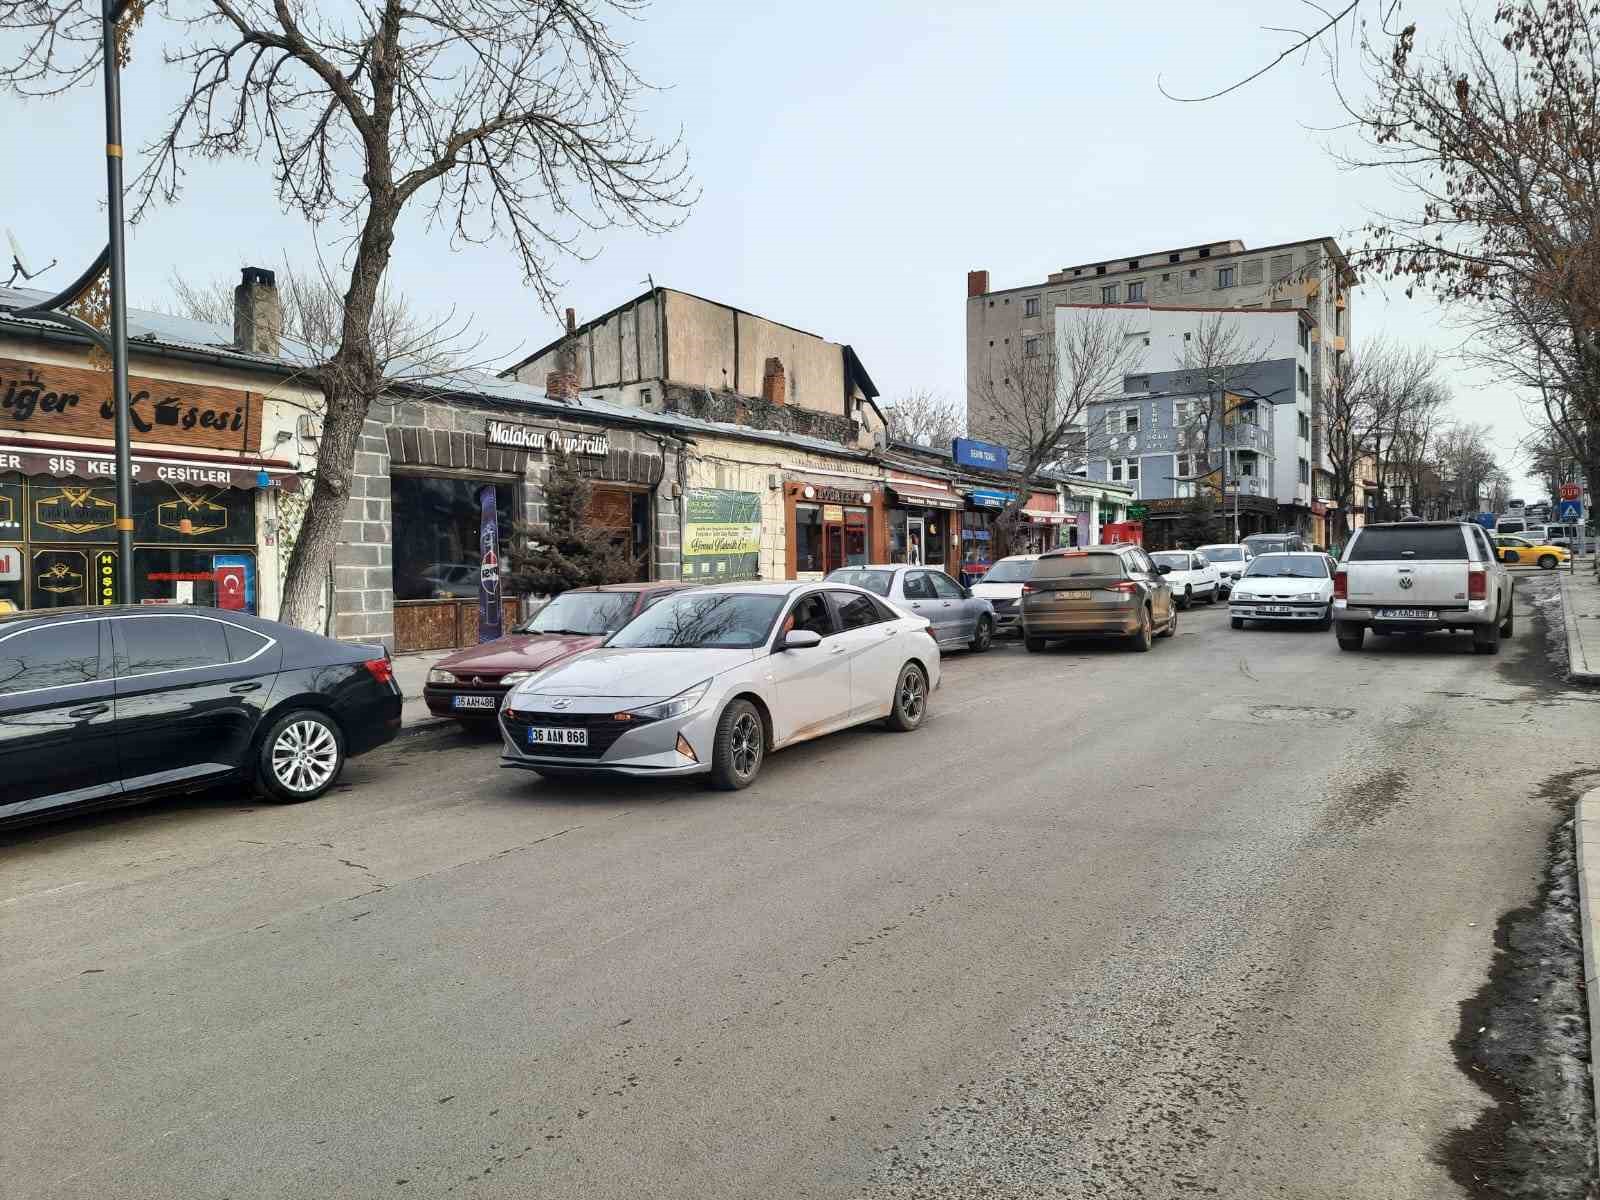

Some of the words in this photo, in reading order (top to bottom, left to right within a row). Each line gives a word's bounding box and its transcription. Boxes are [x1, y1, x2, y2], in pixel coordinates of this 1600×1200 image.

[0, 376, 80, 421] iğer
[100, 389, 244, 432] Kşesi
[48, 456, 76, 474] ŞİŞ
[87, 460, 141, 476] KEBP
[156, 466, 230, 483] ÇEŞİTLERİ
[533, 729, 544, 741] 36
[547, 730, 563, 742] AAN
[567, 731, 585, 743] 868
